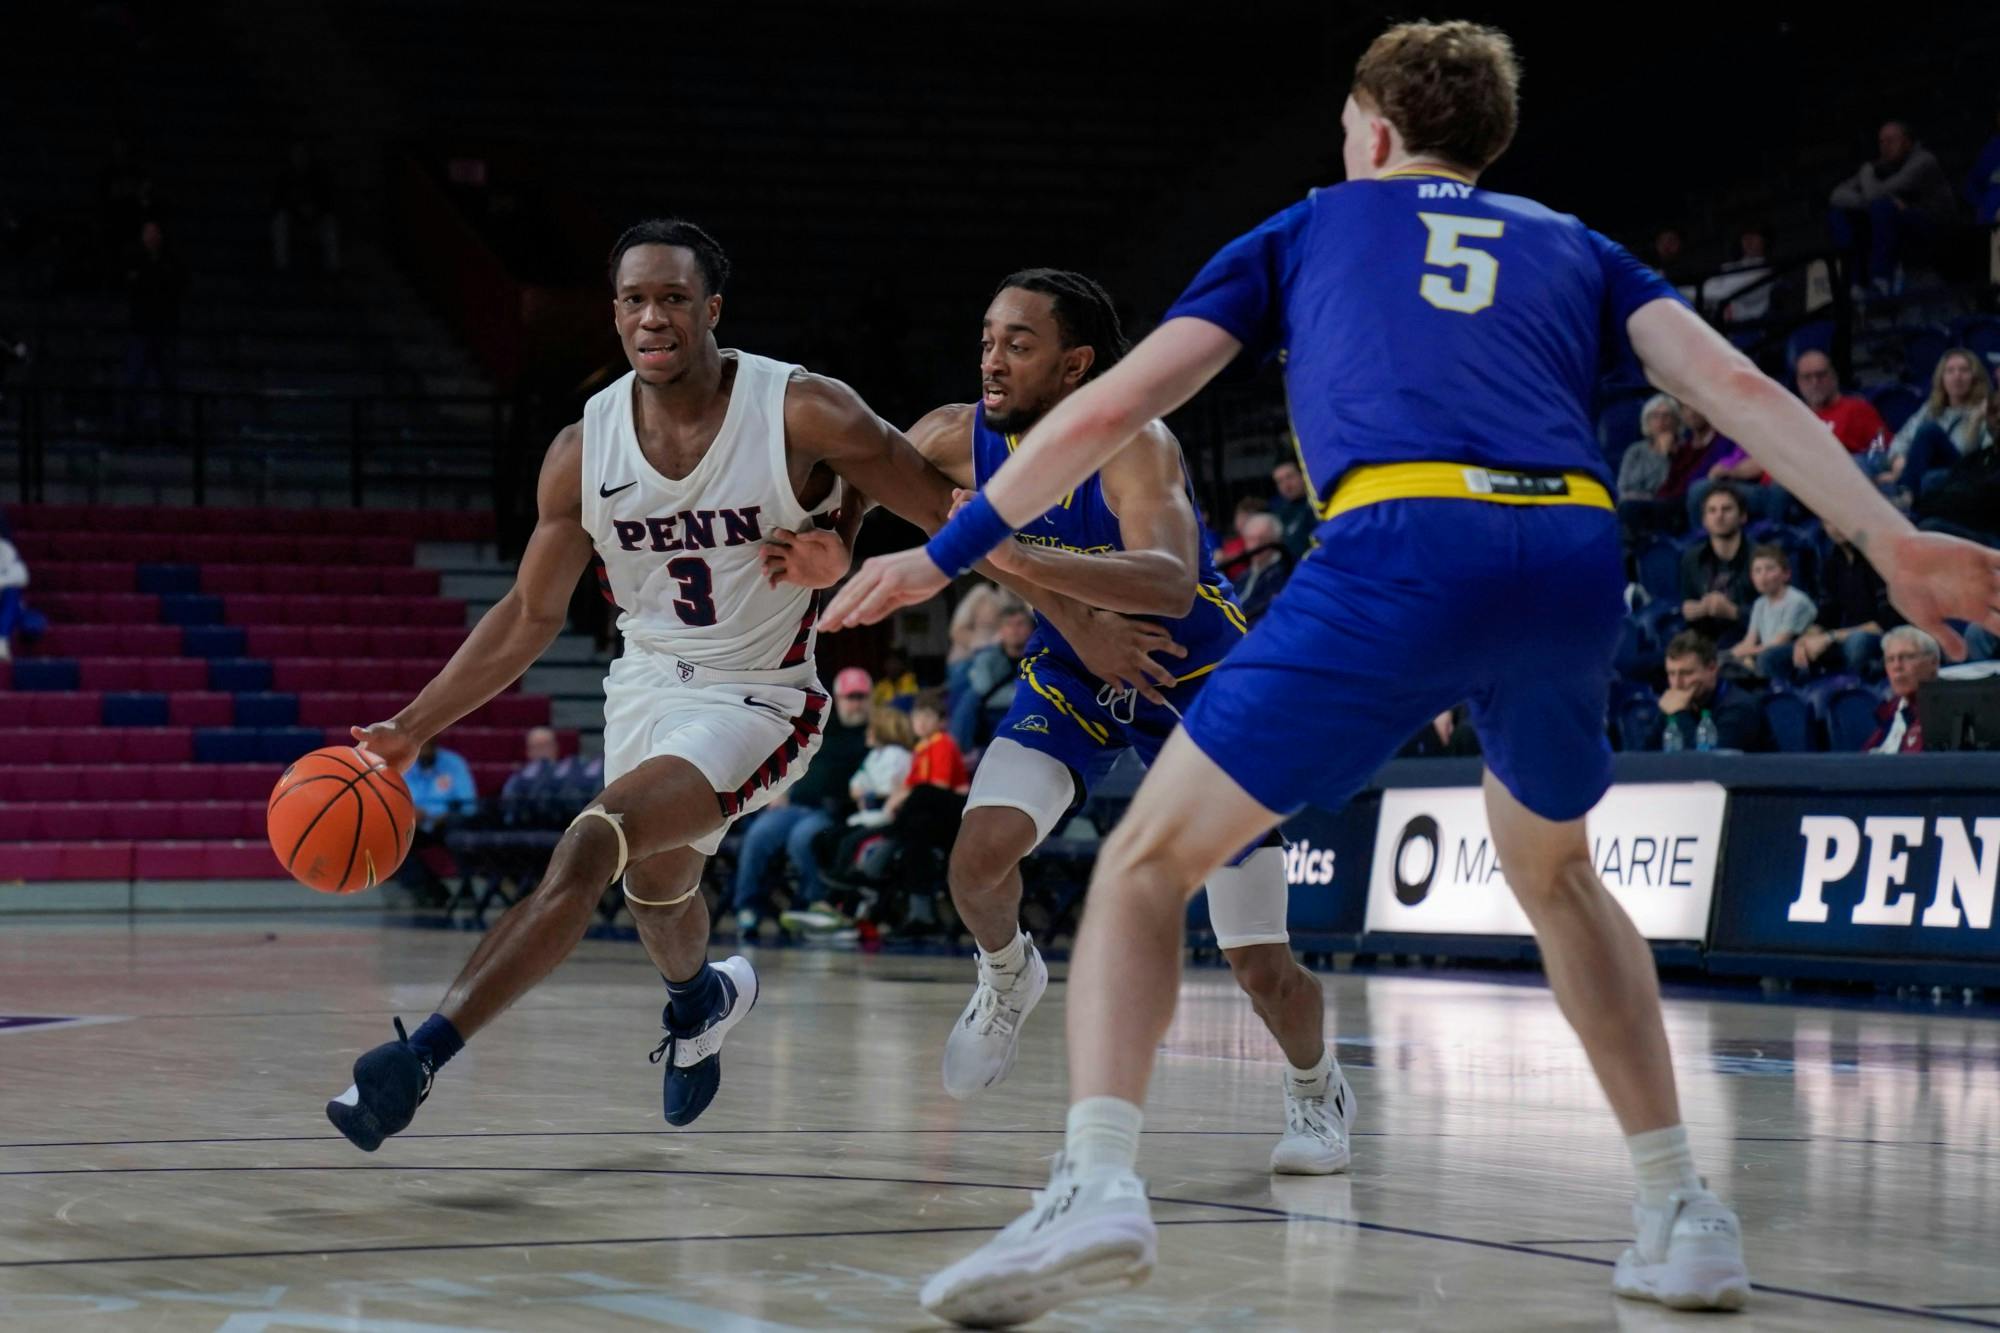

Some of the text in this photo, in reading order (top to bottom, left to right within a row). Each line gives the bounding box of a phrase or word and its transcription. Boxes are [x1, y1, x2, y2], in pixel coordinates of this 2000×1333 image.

[1417, 182, 1474, 199] RAY
[1416, 211, 1505, 314] 5
[613, 505, 762, 552] PENN
[666, 556, 717, 627] 3
